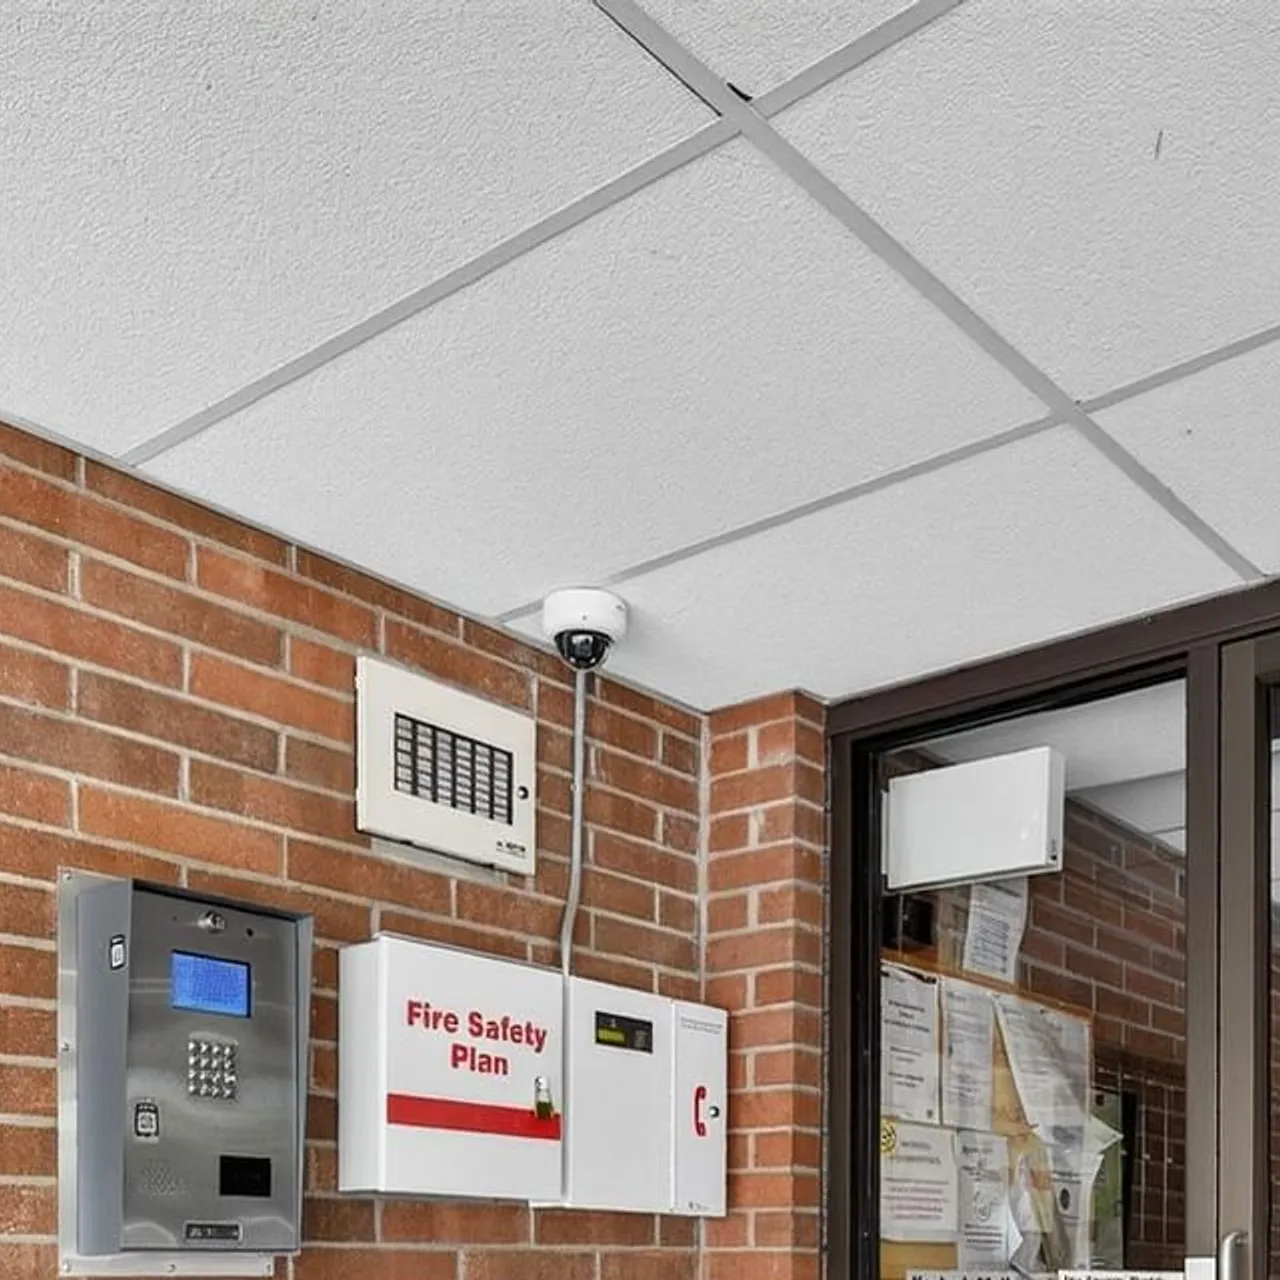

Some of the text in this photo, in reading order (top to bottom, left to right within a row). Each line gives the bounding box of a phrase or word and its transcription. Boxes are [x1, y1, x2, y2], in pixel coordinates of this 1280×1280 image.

[407, 1000, 547, 1054] Fire Safety
[451, 1043, 509, 1076] Plan
